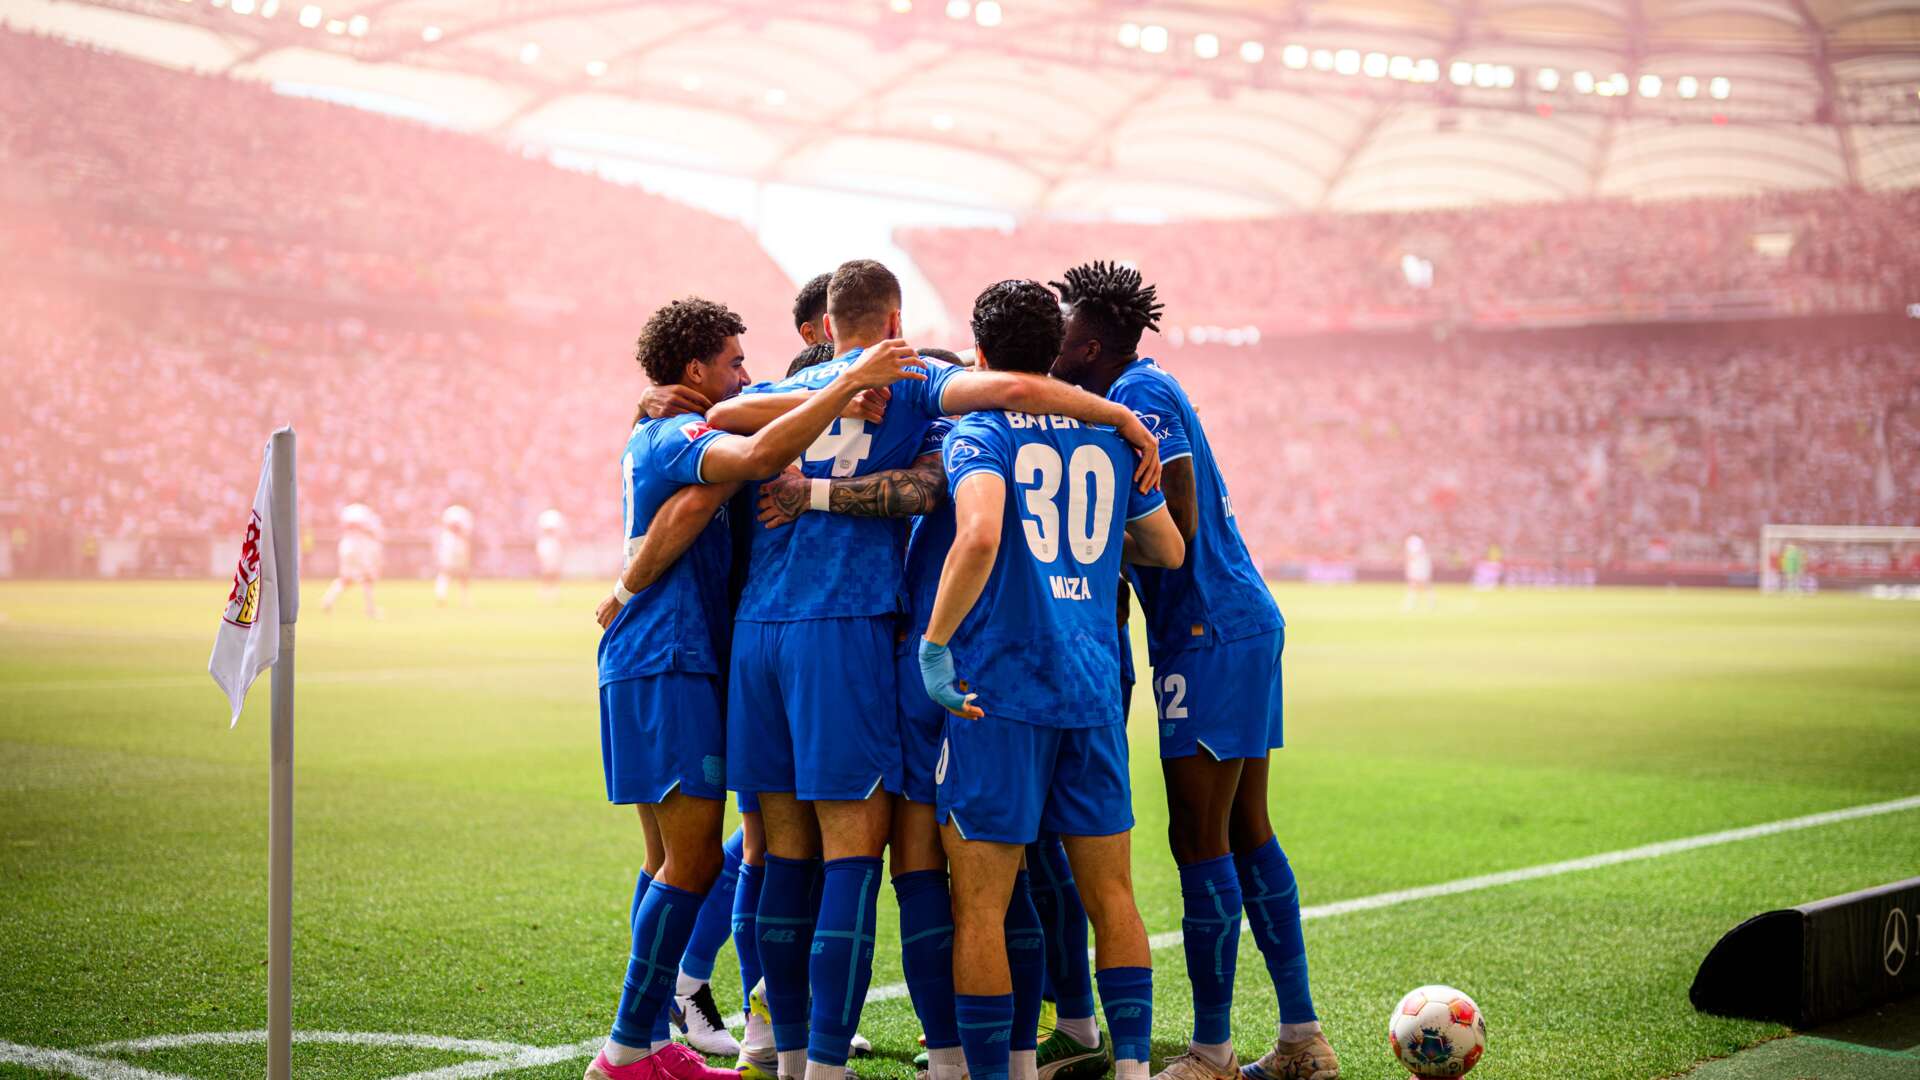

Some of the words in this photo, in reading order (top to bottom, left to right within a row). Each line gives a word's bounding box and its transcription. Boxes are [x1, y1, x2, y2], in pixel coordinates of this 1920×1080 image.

[777, 361, 849, 387] AYER
[792, 417, 873, 478] 4
[1015, 443, 1116, 565] 30
